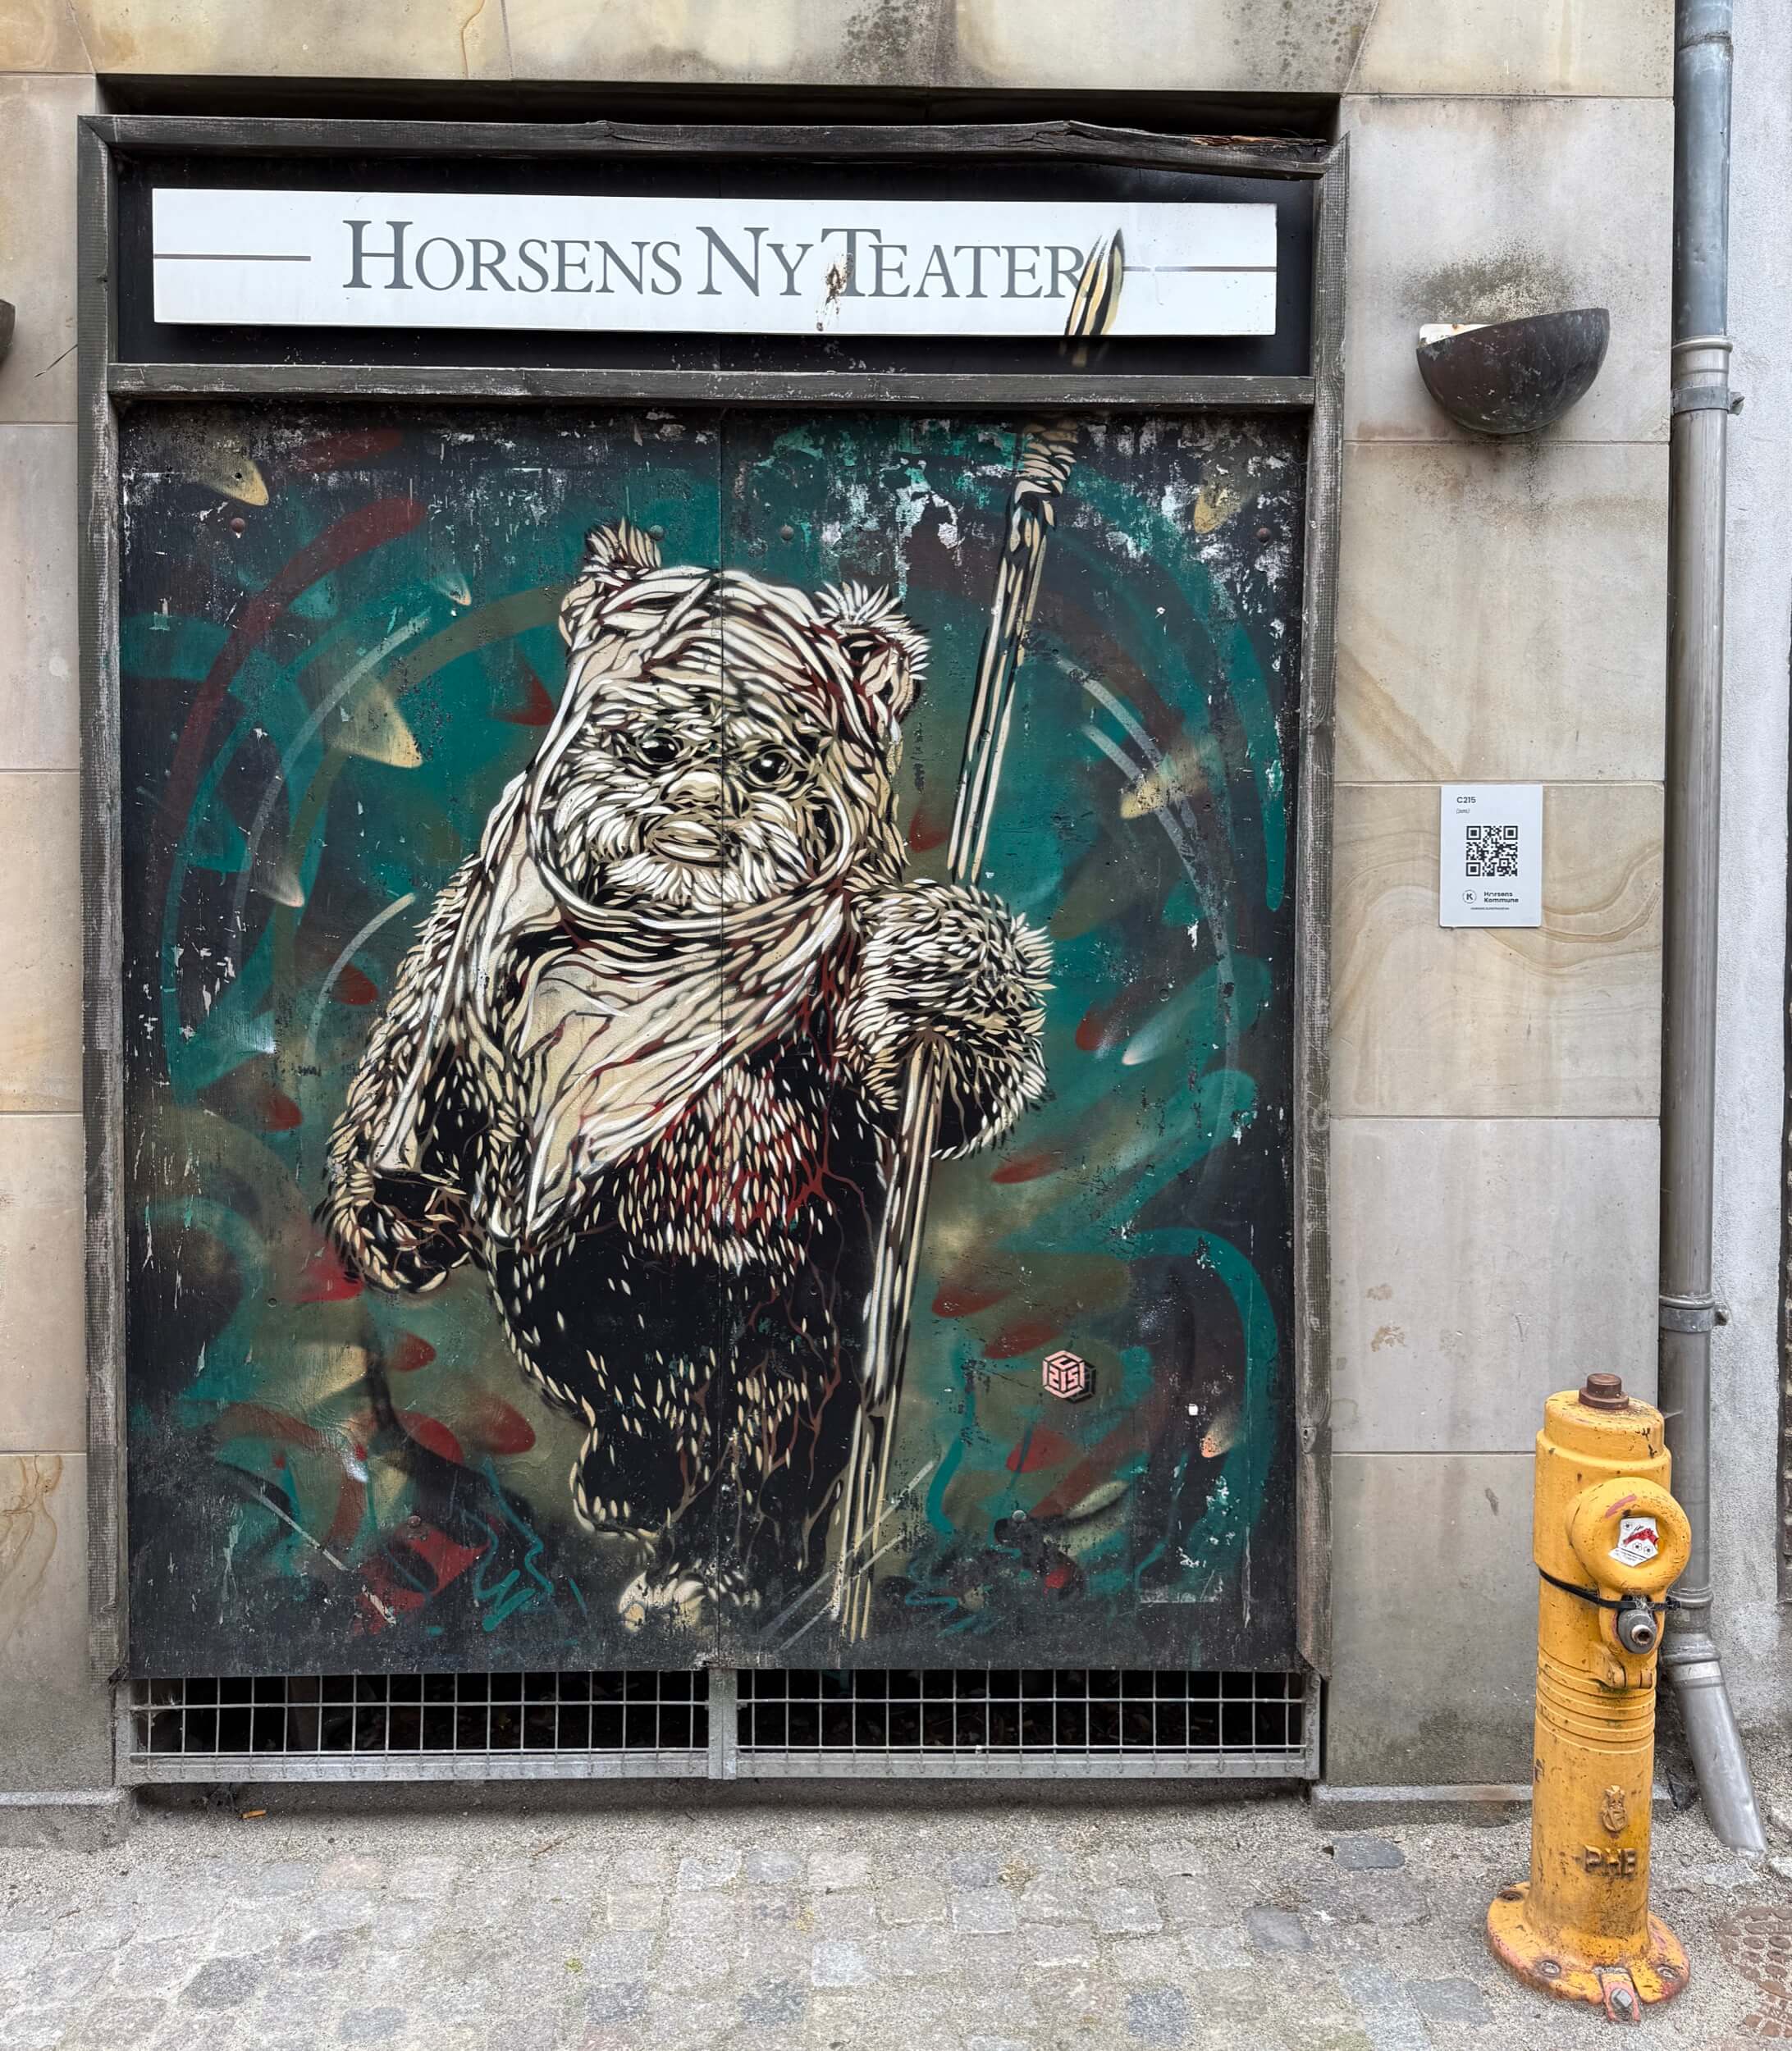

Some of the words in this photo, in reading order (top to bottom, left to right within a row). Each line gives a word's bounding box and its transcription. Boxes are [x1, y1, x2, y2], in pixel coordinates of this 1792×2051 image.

[342, 220, 682, 295] HORSENS
[696, 226, 814, 297] NY
[821, 228, 1086, 298] TEATER
[1456, 796, 1477, 804] C215
